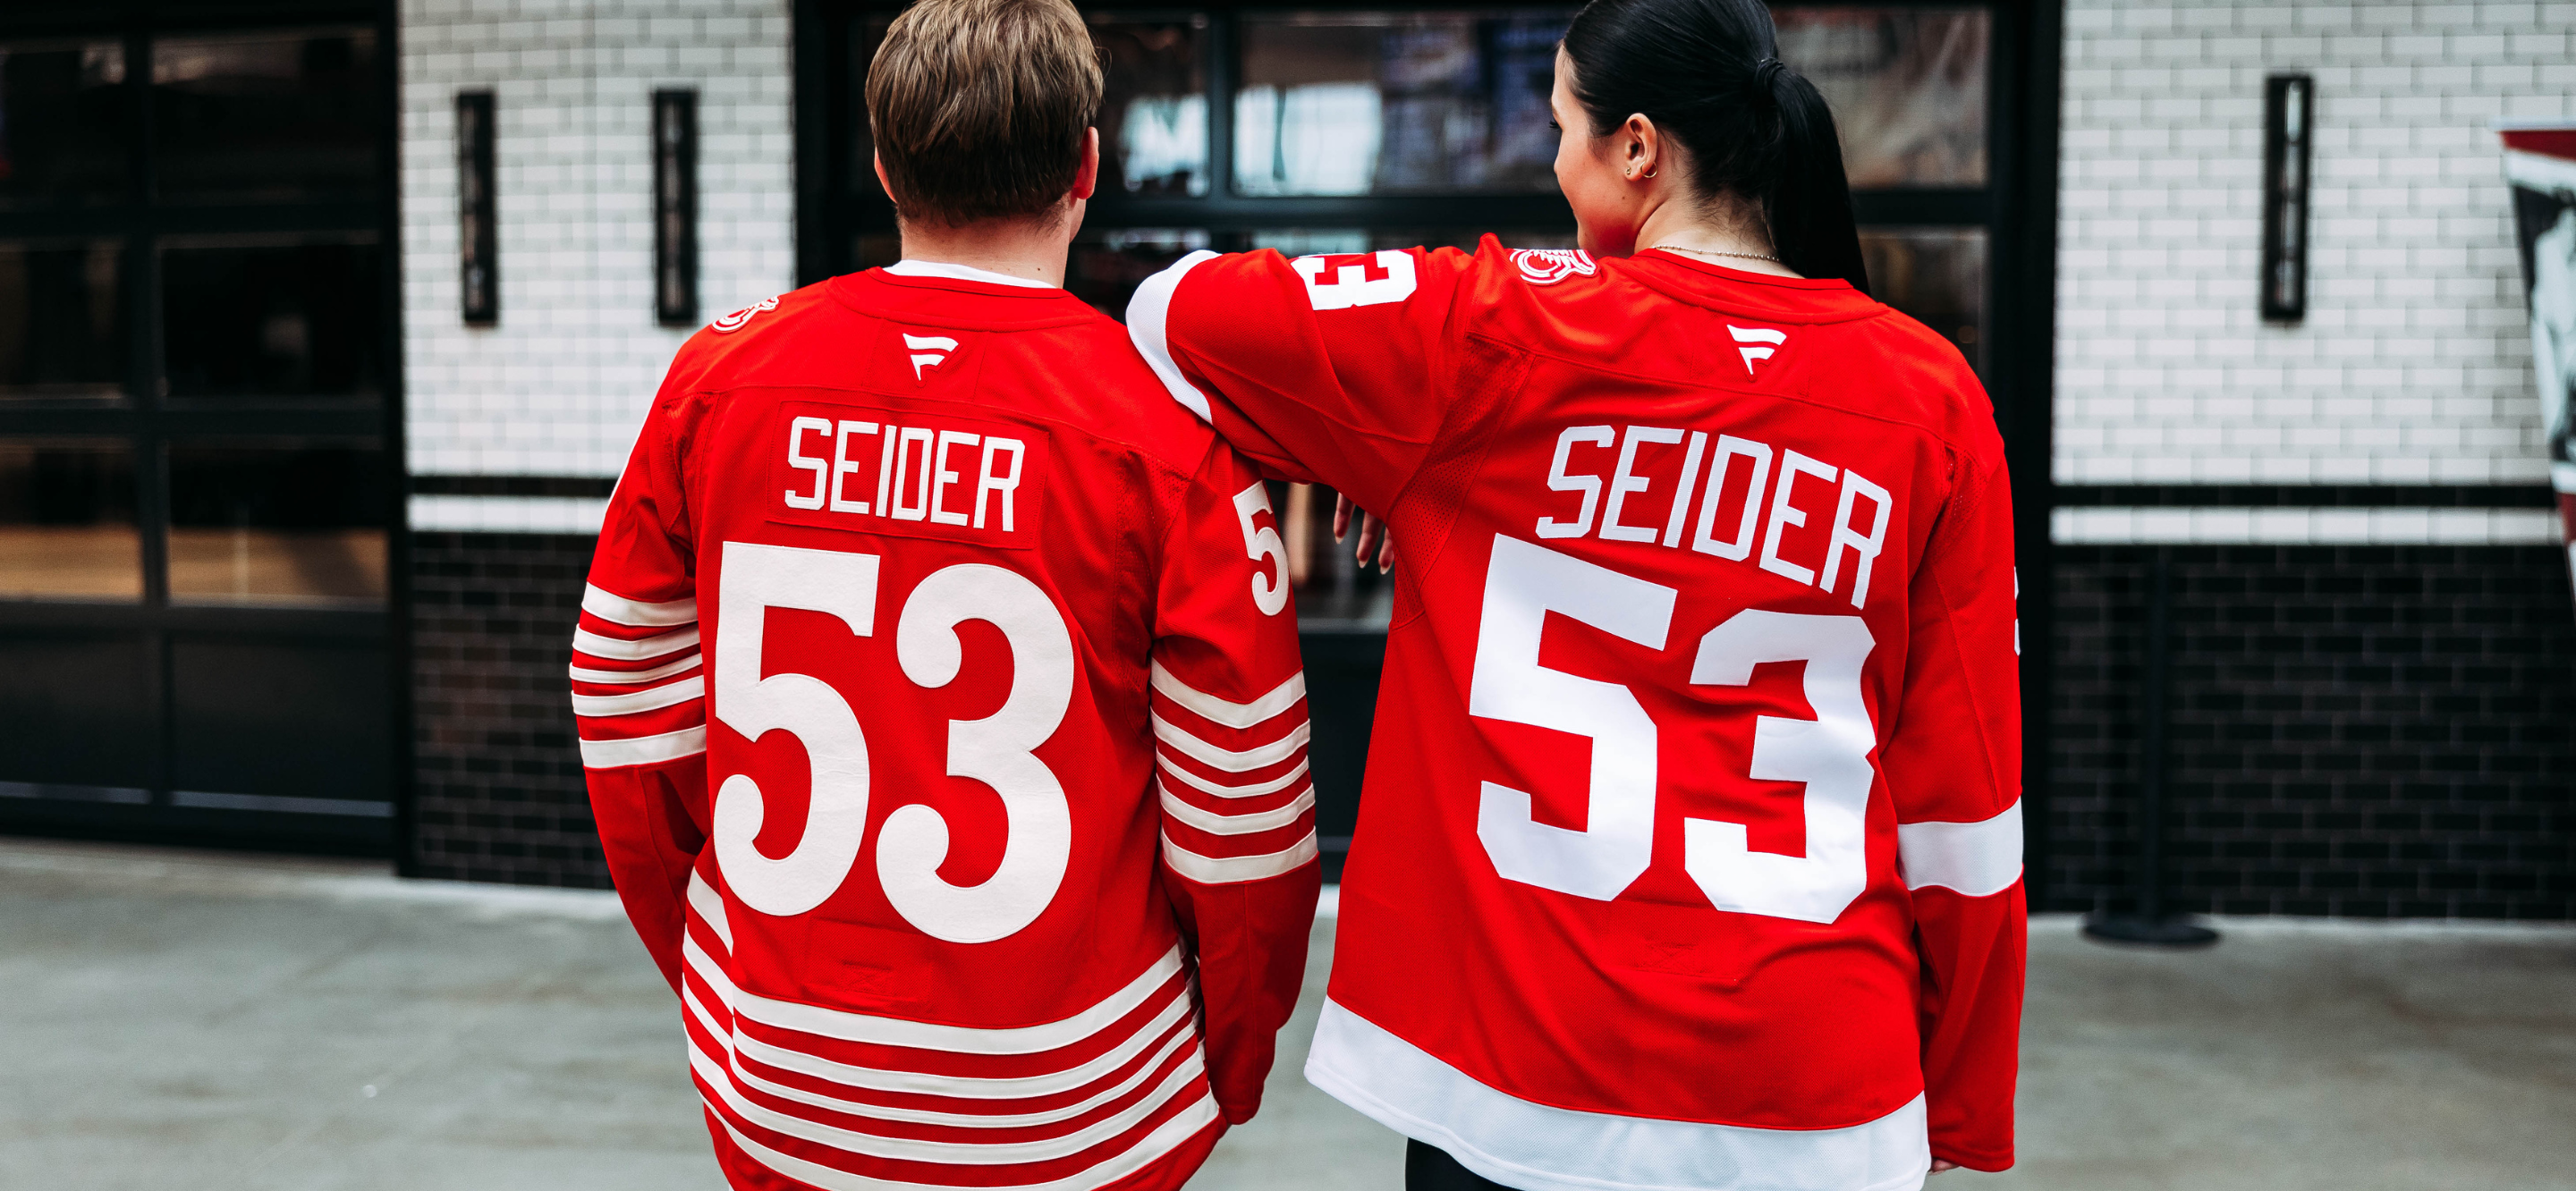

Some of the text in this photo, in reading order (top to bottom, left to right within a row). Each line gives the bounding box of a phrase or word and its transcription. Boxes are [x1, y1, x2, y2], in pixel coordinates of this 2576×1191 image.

[1291, 249, 1417, 311] 3
[785, 417, 1026, 533] SEIDER
[1233, 480, 1289, 616] 5
[1536, 425, 1893, 610] SEIDER
[714, 541, 1075, 943] 53
[1470, 533, 1877, 925] 53
